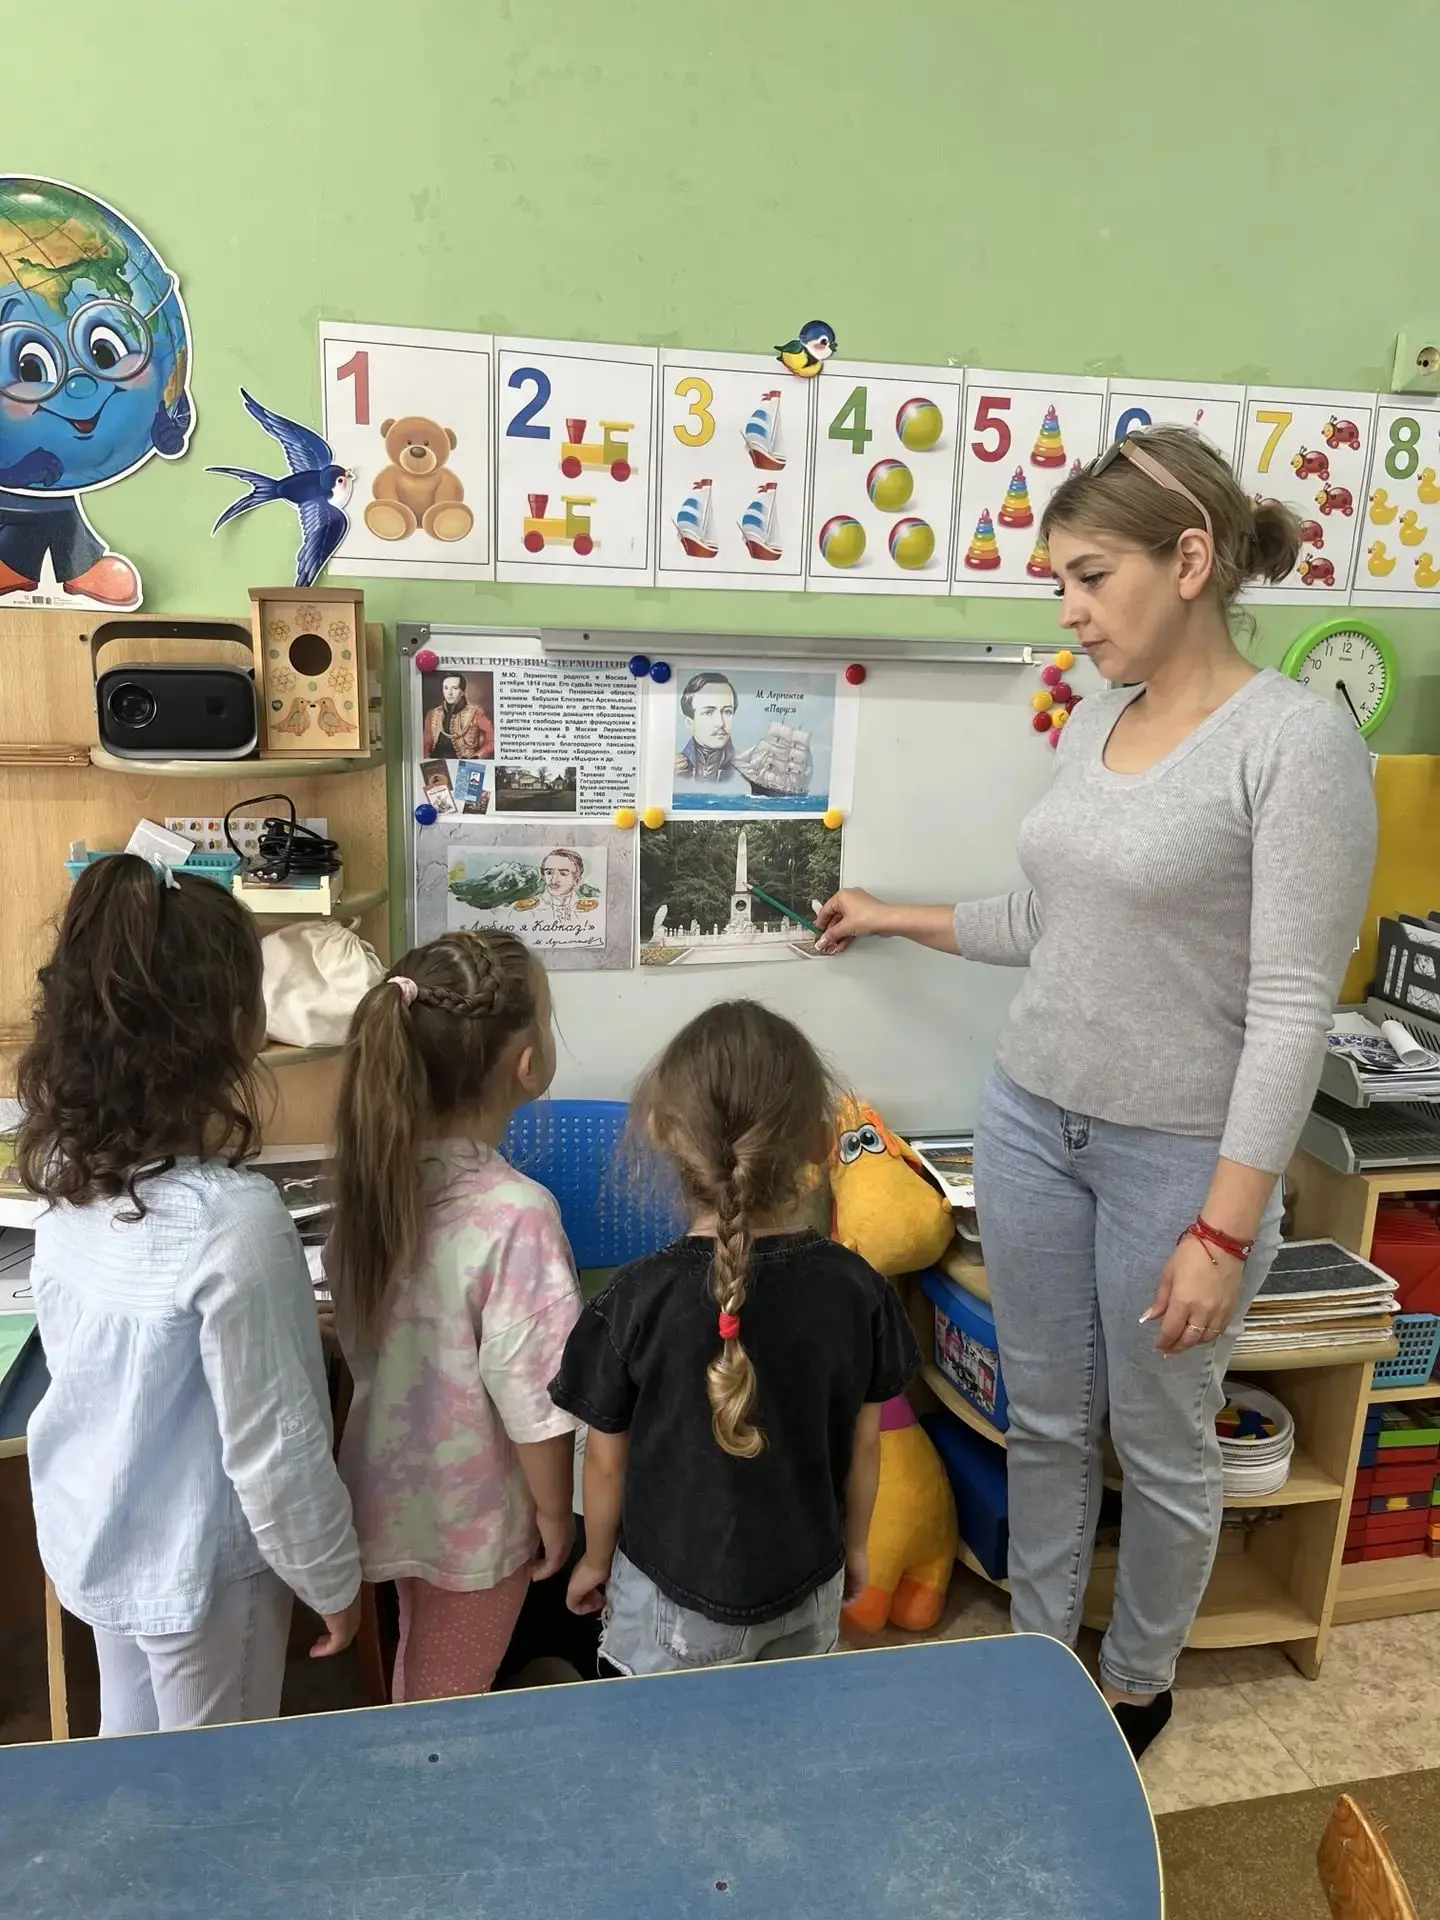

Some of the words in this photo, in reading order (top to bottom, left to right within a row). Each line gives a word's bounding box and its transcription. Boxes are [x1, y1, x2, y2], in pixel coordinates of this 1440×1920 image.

[336, 350, 370, 425] 1
[506, 366, 551, 440] 2
[672, 376, 716, 448] 3
[828, 386, 873, 455] 4
[971, 395, 1012, 463] 5
[1256, 409, 1293, 473] 7
[1385, 416, 1421, 480] 8
[1325, 646, 1334, 656] 11
[1342, 642, 1353, 653] 12
[1360, 648, 1365, 660] 1
[440, 656, 484, 665] ИХАИЛ
[489, 657, 548, 667] ЮРЬЕВИЧ
[552, 660, 627, 669] ЛЕРМОНТОВ
[1312, 659, 1322, 670] 10
[1368, 664, 1375, 675] 2
[1304, 676, 1310, 686] 9
[1368, 682, 1376, 693] 3
[766, 690, 804, 701] Лермонтов
[764, 704, 796, 716] «Парус»
[1360, 702, 1366, 711] 4
[532, 920, 595, 936] Кавказ!»
